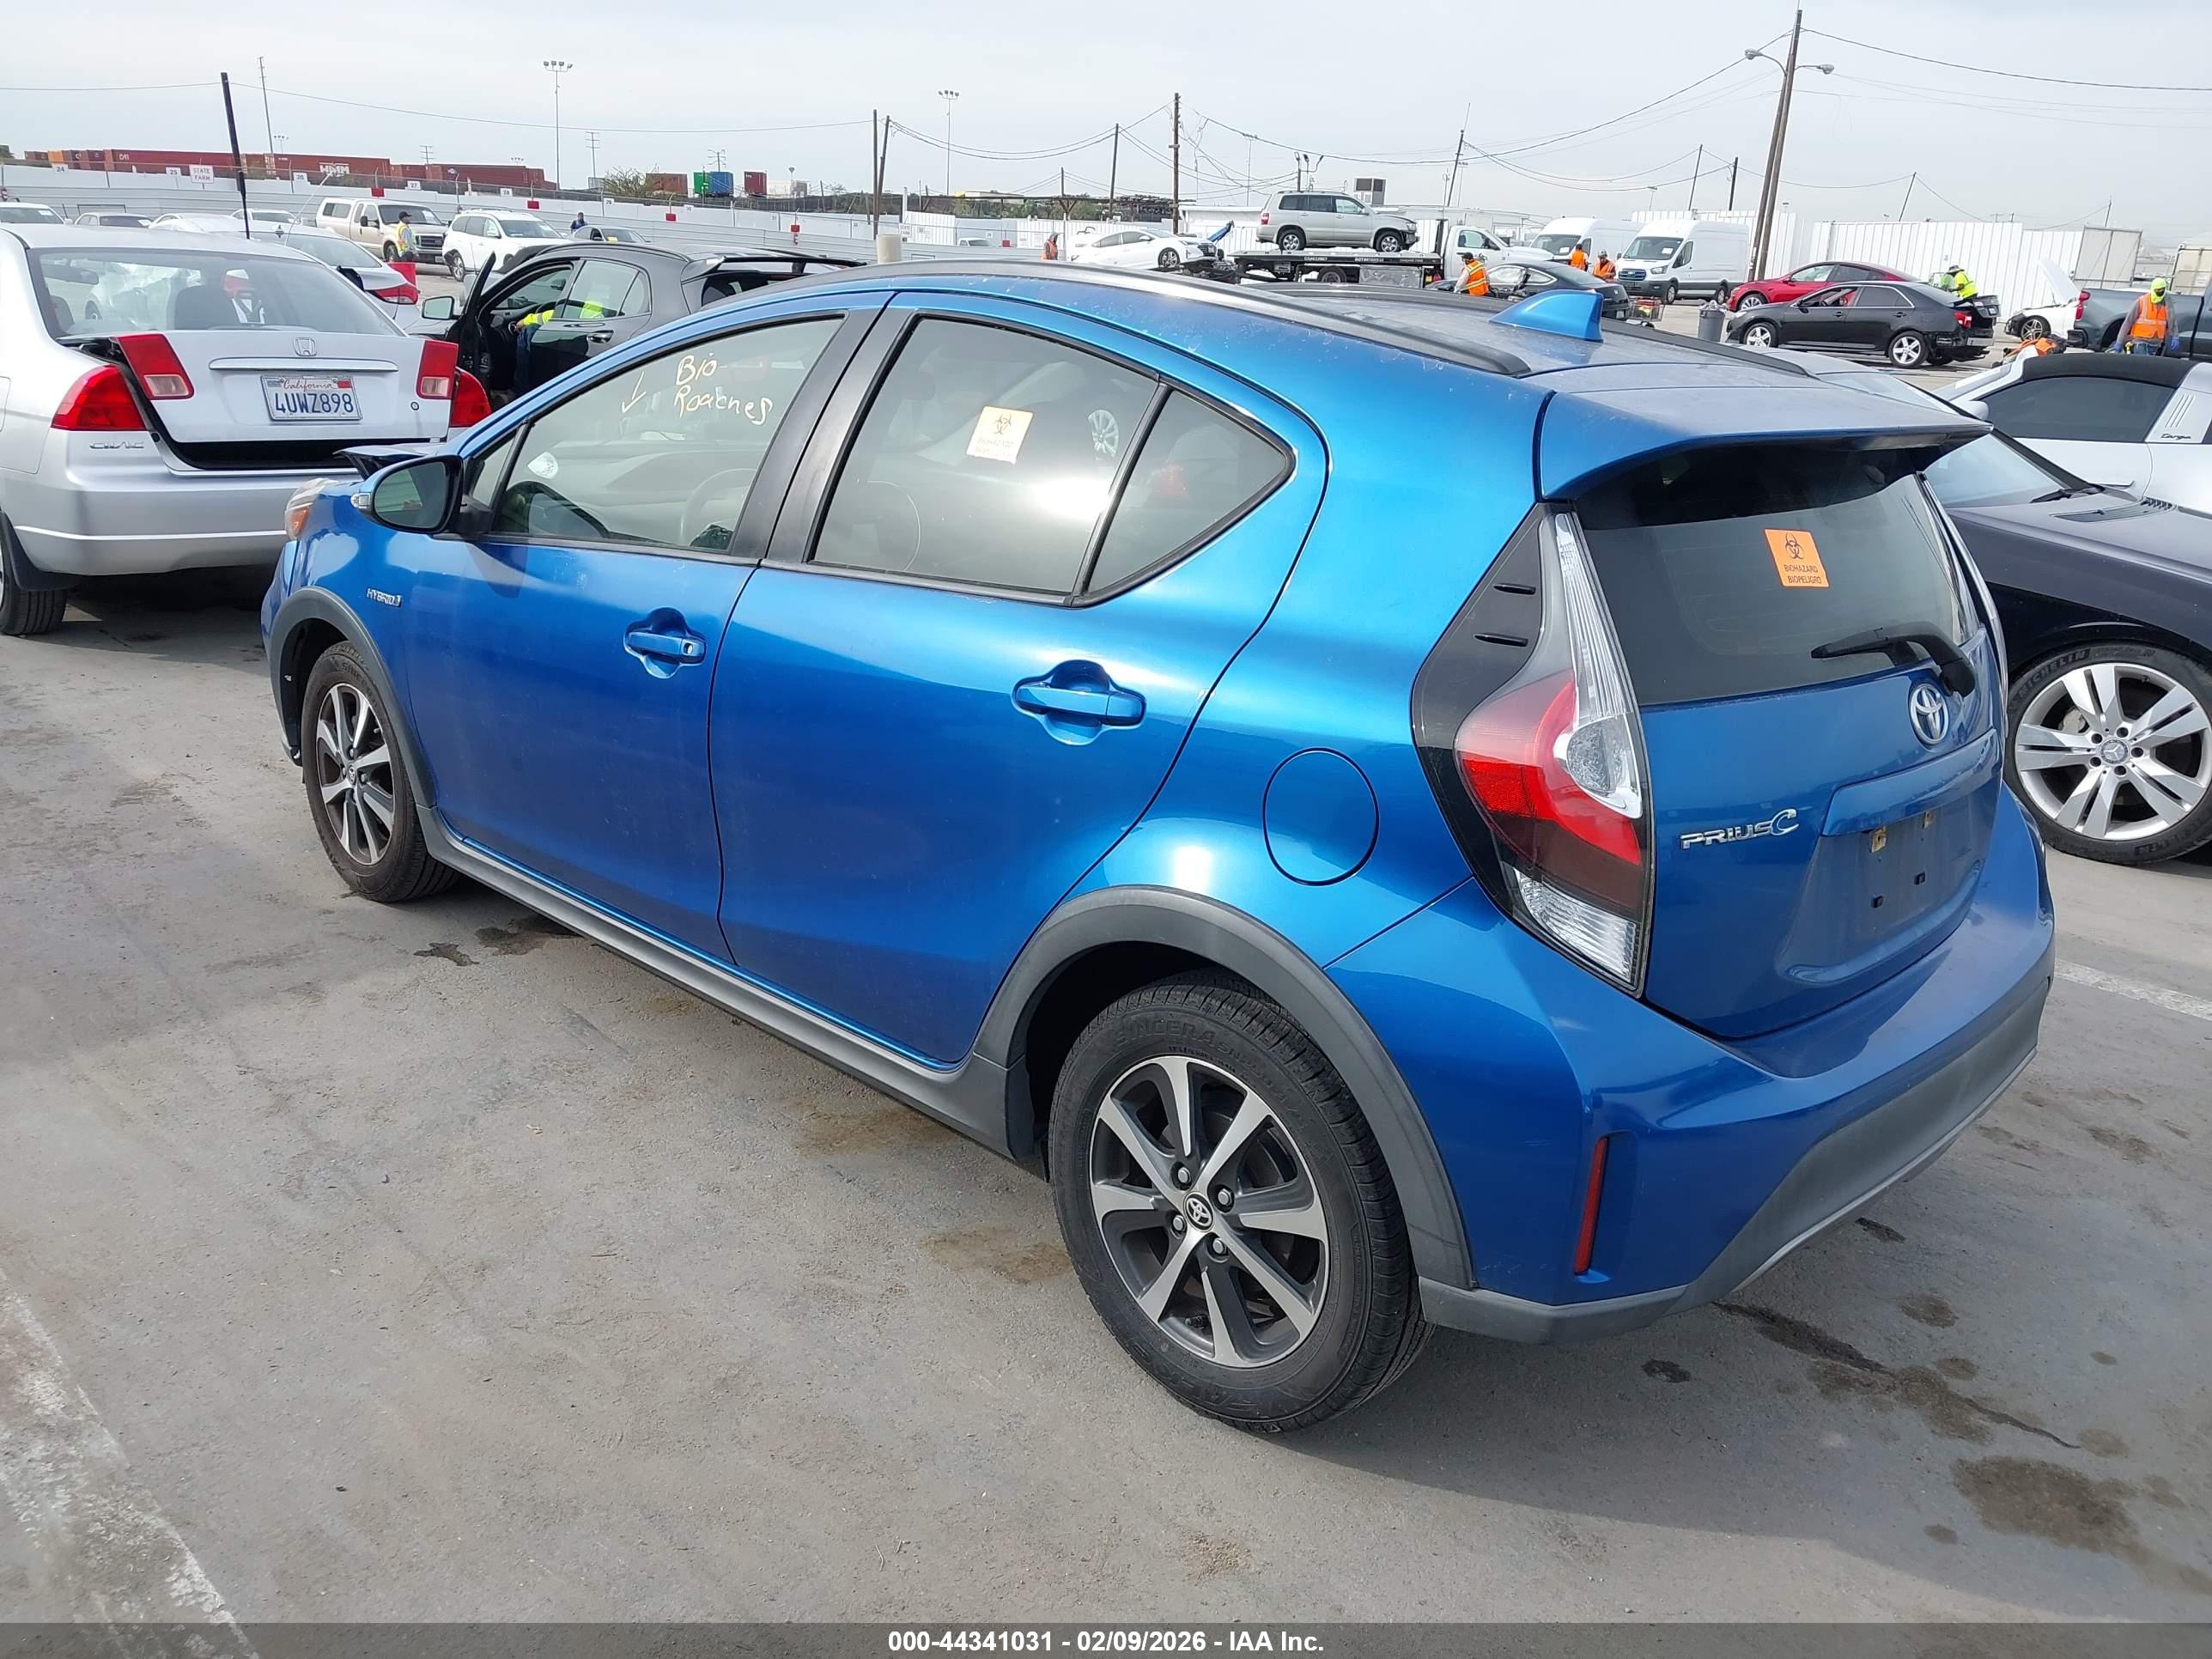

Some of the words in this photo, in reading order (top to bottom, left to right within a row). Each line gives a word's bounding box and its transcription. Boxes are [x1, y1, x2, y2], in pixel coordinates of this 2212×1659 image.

[283, 379, 335, 392] California
[275, 392, 354, 413] 4UWZ898
[1784, 564, 1819, 573] BIOHAZARD
[2018, 650, 2087, 697] MICHELIN
[1680, 820, 1772, 849] PRIUS
